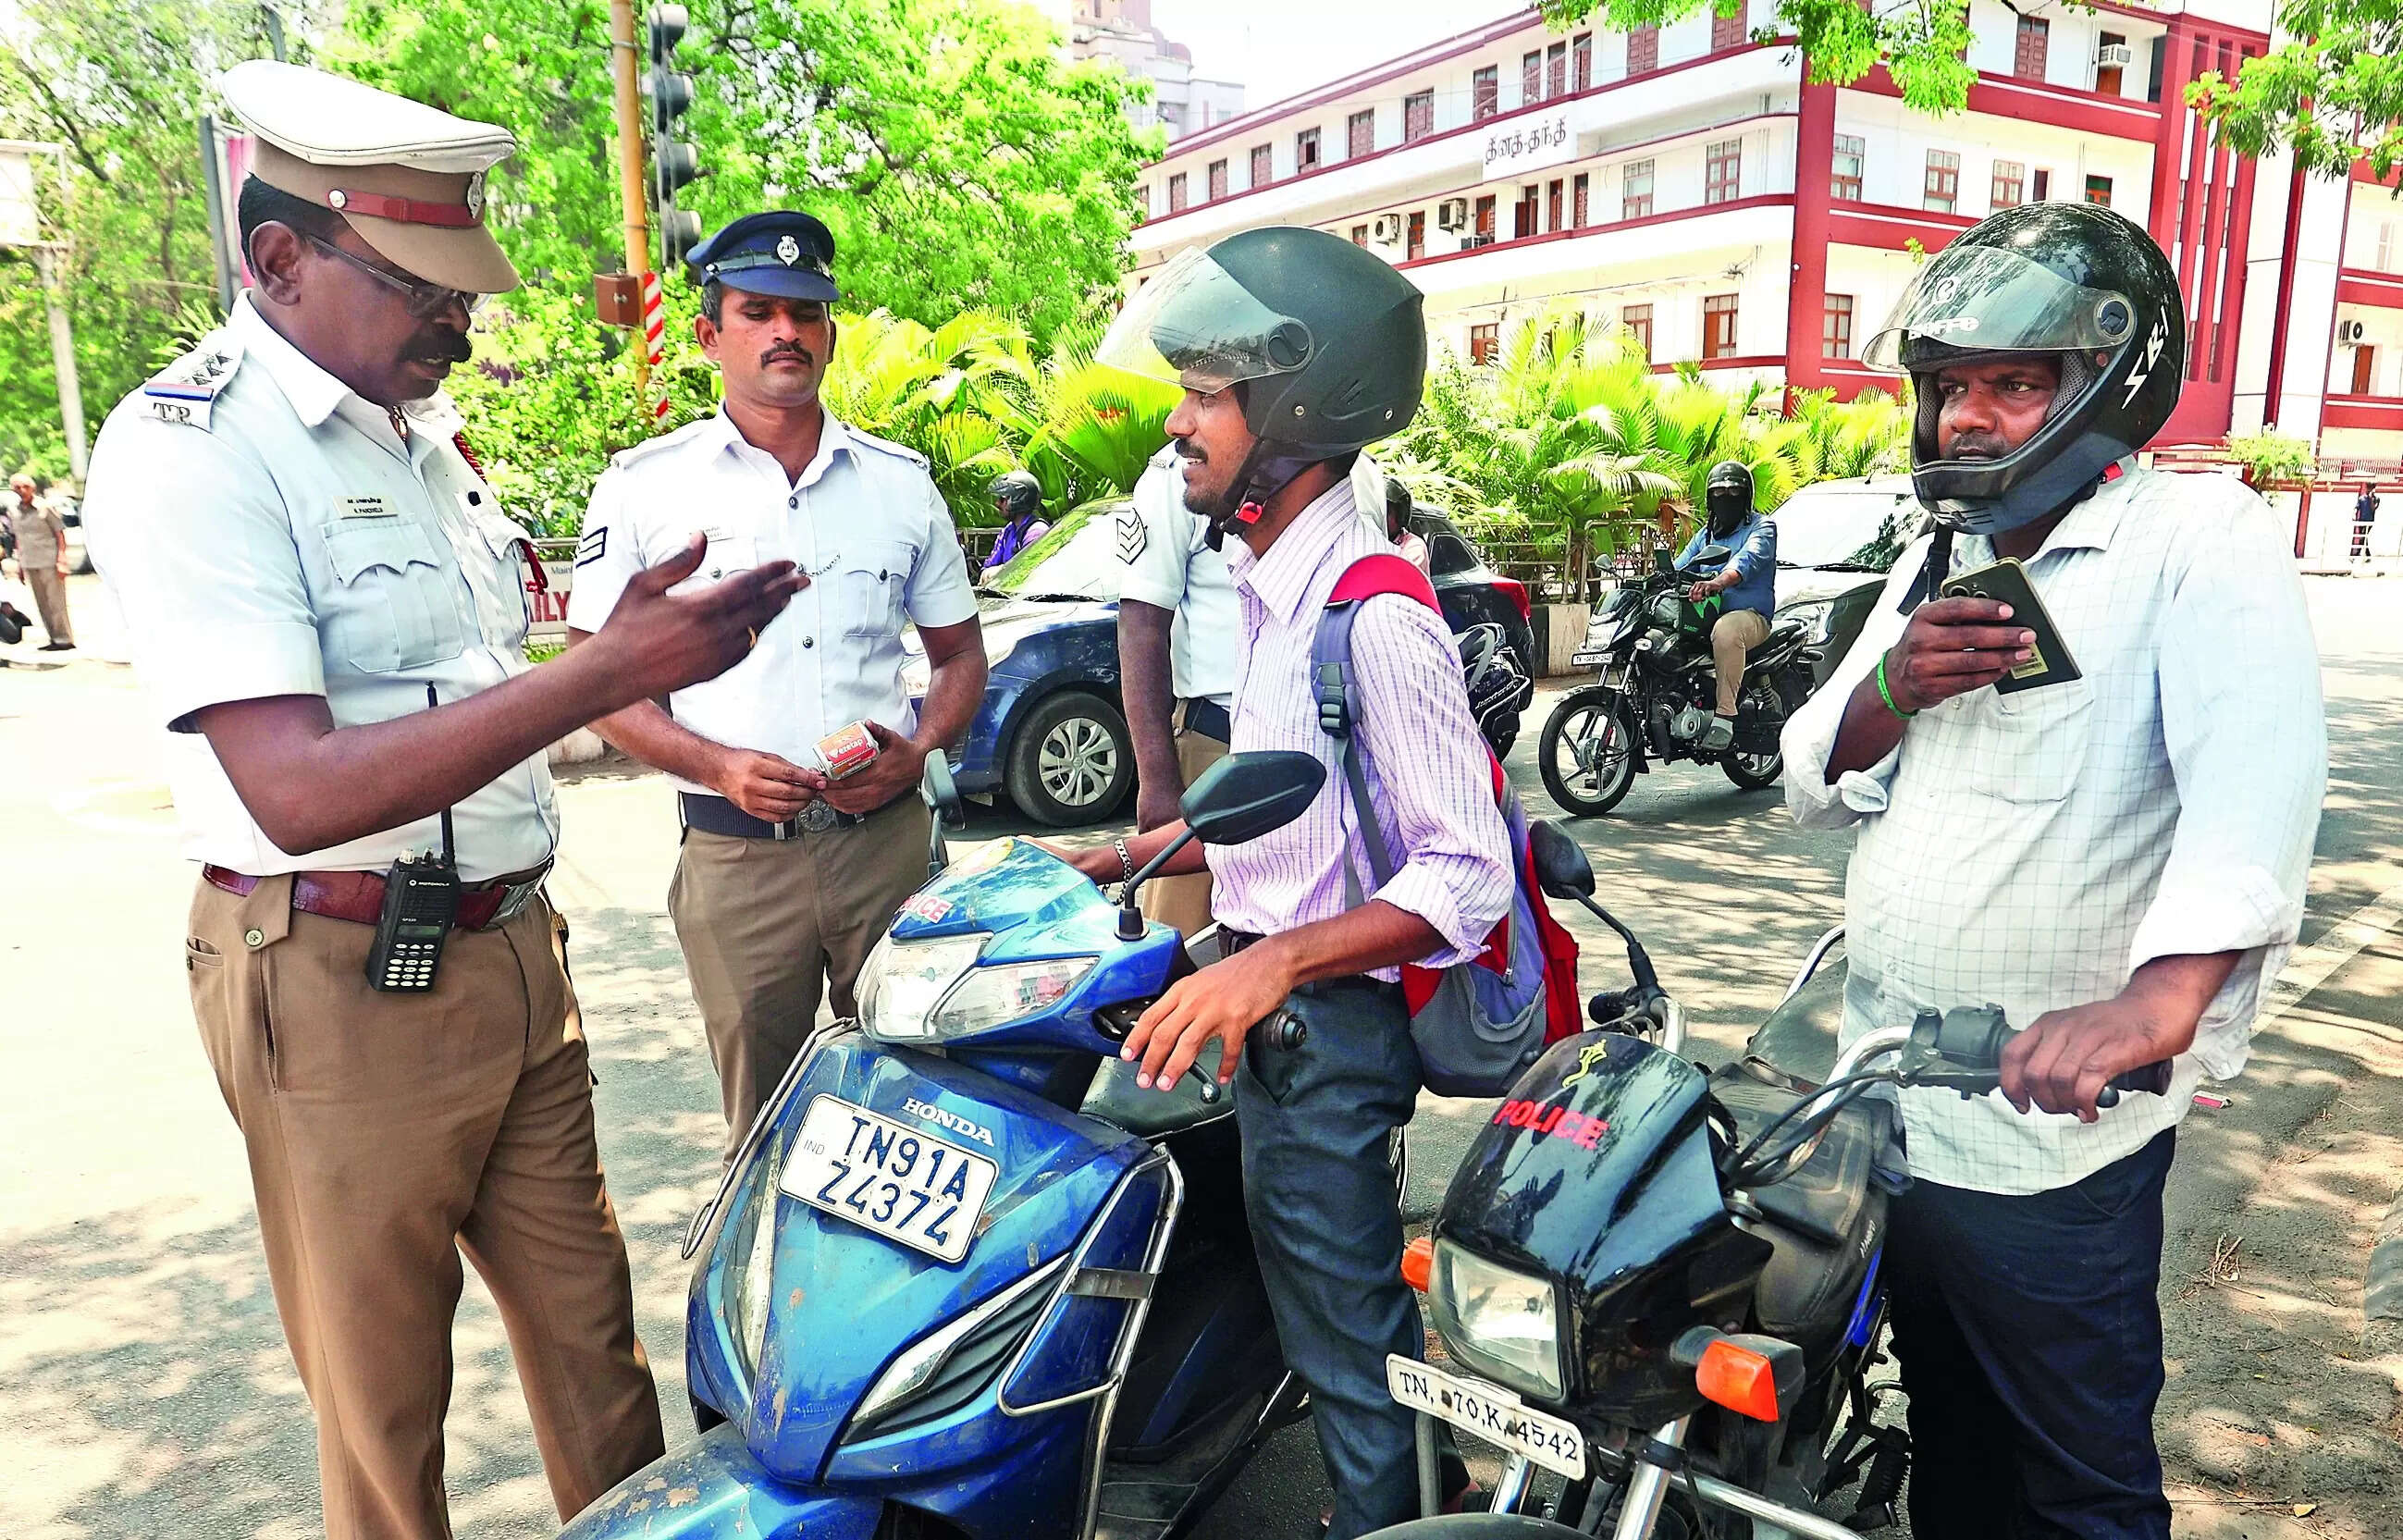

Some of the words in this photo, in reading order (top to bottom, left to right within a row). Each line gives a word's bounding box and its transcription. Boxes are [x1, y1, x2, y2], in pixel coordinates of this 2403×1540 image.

[530, 591, 571, 622] ILY
[902, 1097, 994, 1147] HONDA
[1493, 1100, 1610, 1150] POLICE
[803, 1138, 825, 1155] IND
[844, 1115, 968, 1202] TN91A
[1515, 1418, 1578, 1461] 4542
